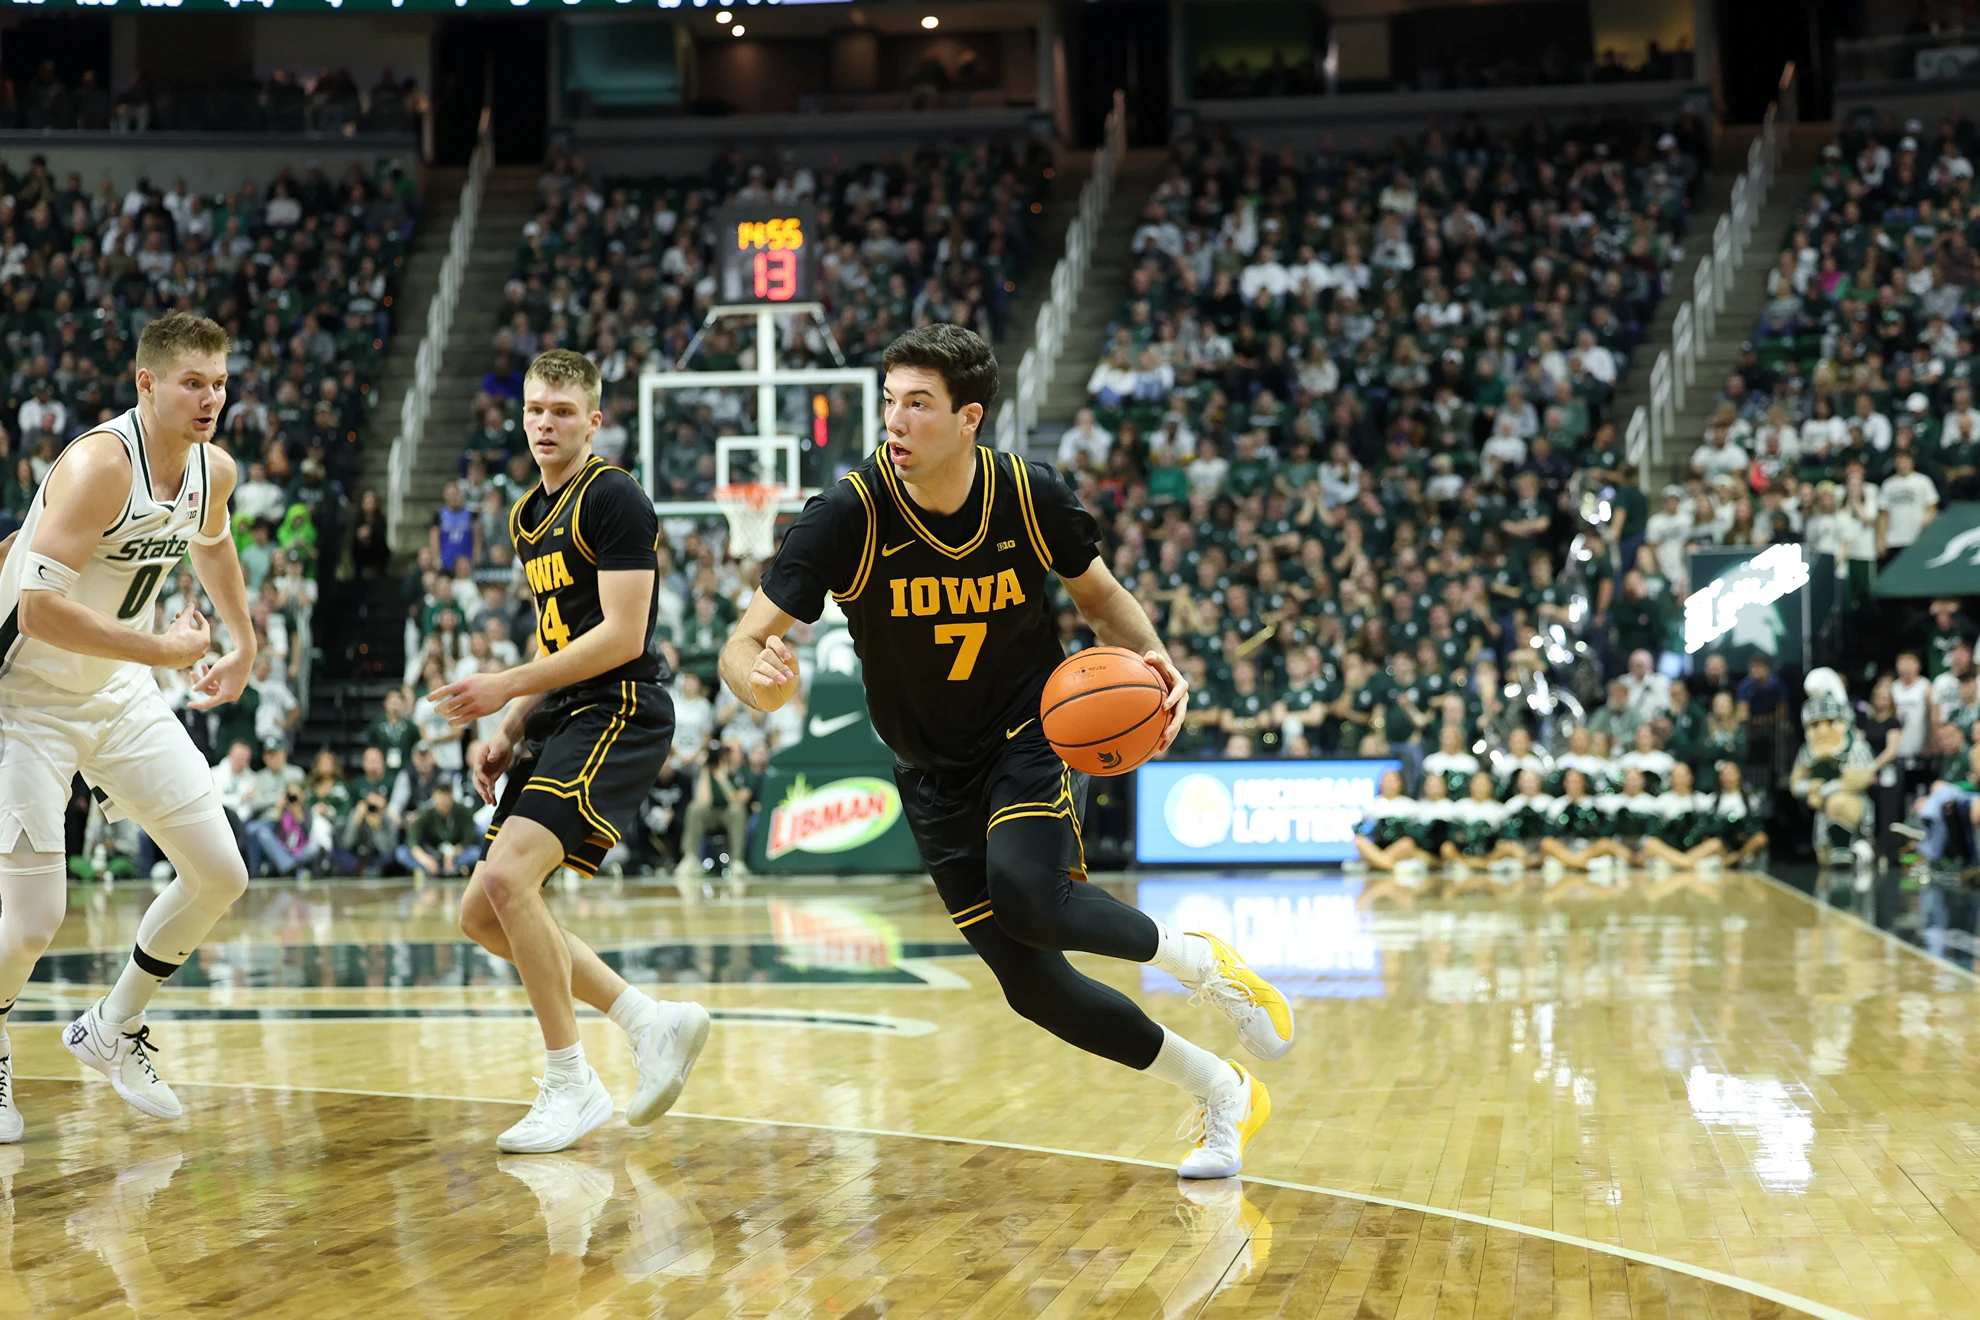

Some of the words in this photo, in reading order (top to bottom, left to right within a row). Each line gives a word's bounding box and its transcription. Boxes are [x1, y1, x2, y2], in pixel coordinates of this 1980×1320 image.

[753, 249, 797, 301] 13
[105, 534, 189, 561] State
[117, 564, 163, 619] 0
[889, 567, 1026, 617] IOWA
[934, 622, 988, 681] 7
[770, 793, 886, 853] LIBMAN
